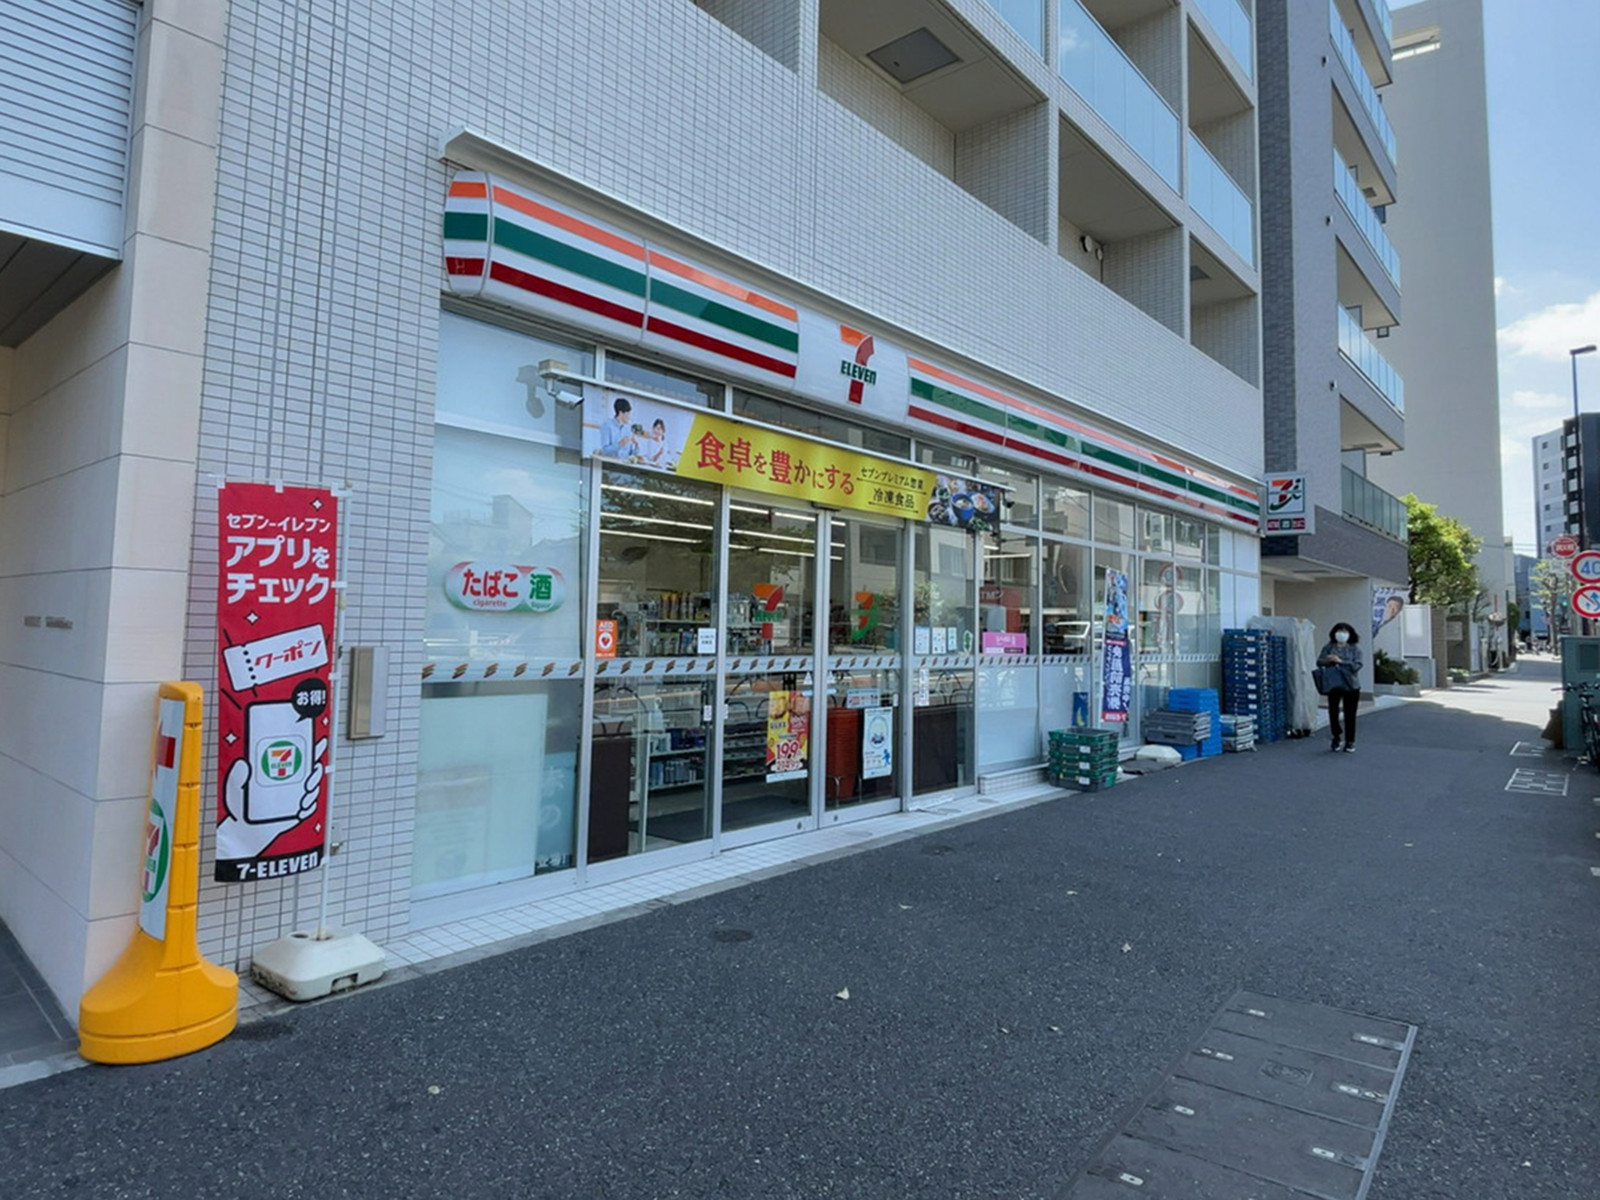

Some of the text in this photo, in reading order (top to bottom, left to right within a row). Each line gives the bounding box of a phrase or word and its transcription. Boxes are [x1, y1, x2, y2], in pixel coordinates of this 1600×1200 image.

[695, 431, 855, 495] 食卓を豊かにする
[873, 487, 916, 509] 冷凍食品
[226, 535, 330, 570] アプリを
[226, 573, 330, 605] チェック
[462, 569, 519, 598] たばこ
[529, 573, 552, 600] 酒
[254, 640, 322, 669] クーポン
